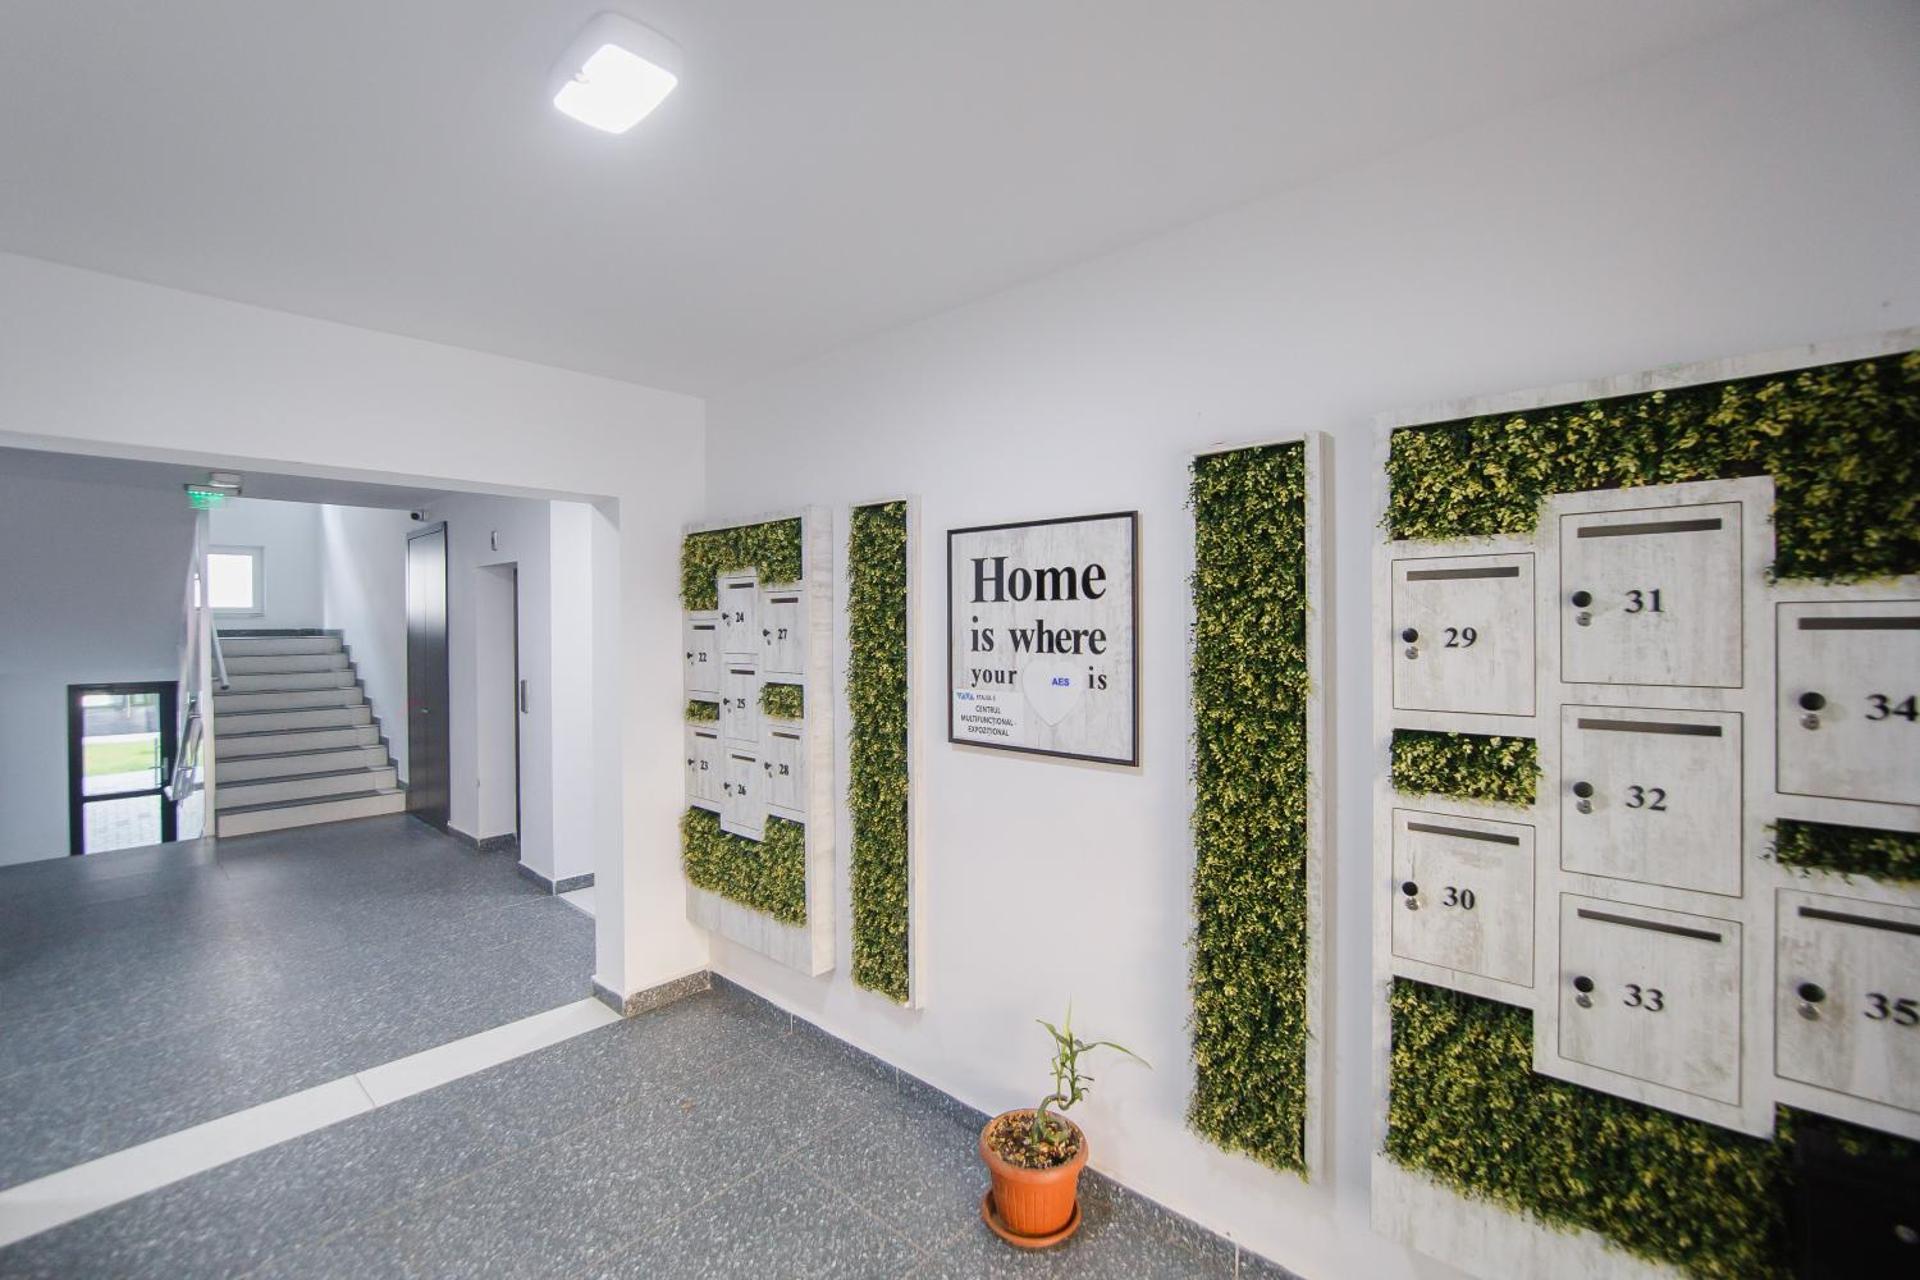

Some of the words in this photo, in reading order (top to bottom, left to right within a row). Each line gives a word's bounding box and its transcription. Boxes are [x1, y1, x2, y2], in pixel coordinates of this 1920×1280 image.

[970, 556, 1106, 604] Home
[1624, 588, 1664, 614] 31
[735, 612, 745, 623] 24
[777, 628, 788, 640] 27
[971, 616, 994, 652] is
[1008, 619, 1107, 655] where
[1444, 627, 1478, 648] 29
[971, 668, 1018, 688] your
[1052, 678, 1070, 686] AES
[1088, 666, 1107, 690] is
[736, 698, 746, 709] 25
[1864, 693, 1920, 722] 34
[699, 760, 709, 770] 23
[779, 763, 790, 776] 28
[737, 784, 747, 796] 26
[1625, 785, 1667, 812] 32
[1443, 886, 1476, 911] 30
[1624, 984, 1665, 1012] 33
[1864, 992, 1920, 1027] 35
